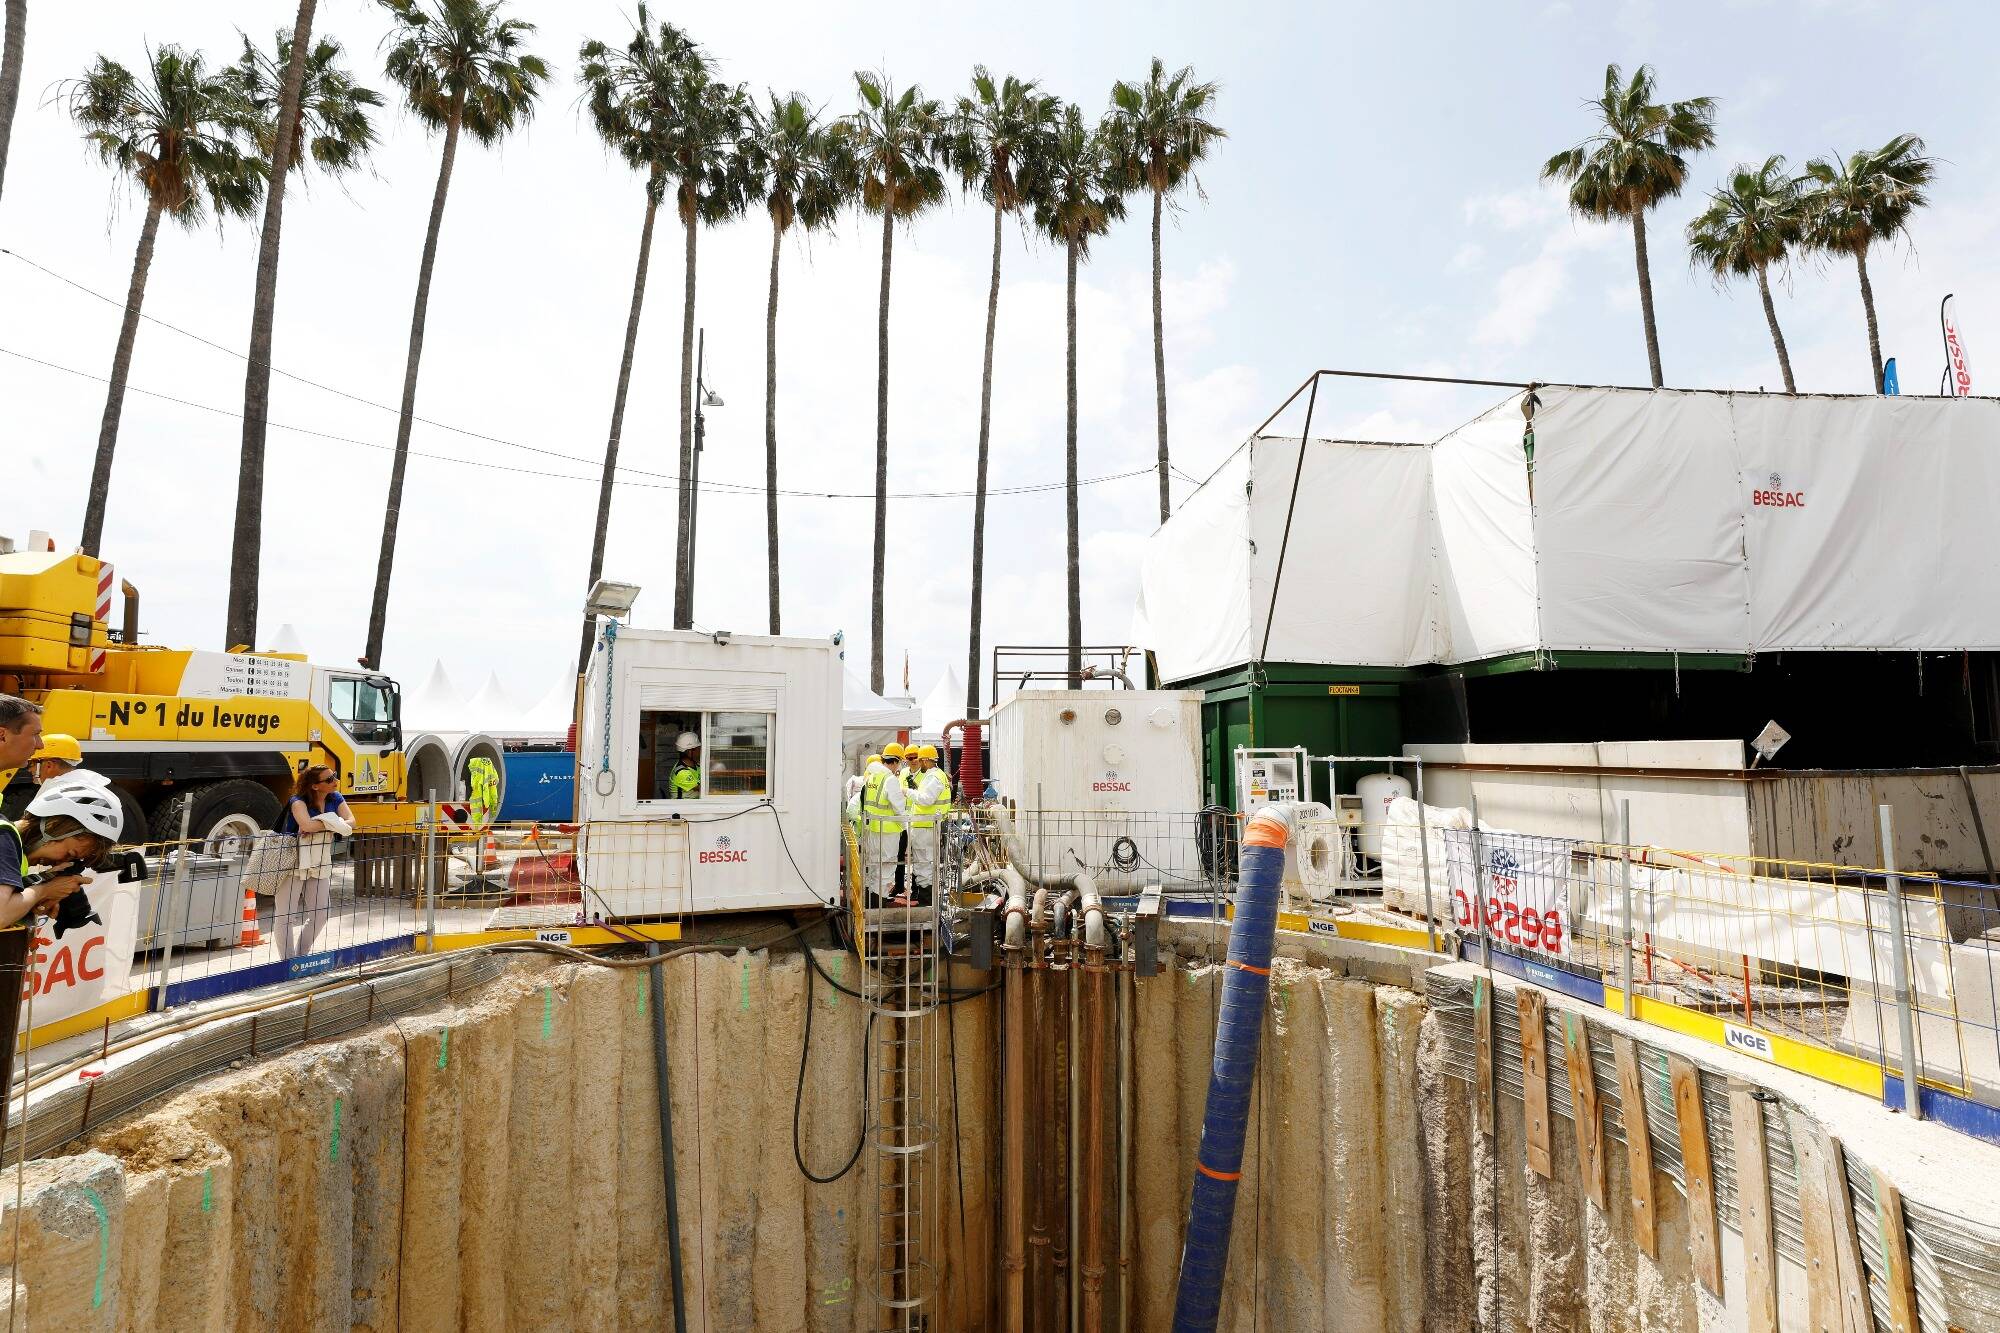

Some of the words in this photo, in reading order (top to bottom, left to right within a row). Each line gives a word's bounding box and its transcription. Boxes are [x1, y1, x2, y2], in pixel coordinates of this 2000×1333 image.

[155, 702, 166, 727] 1
[176, 703, 204, 728] du
[212, 705, 280, 735] levage
[1312, 921, 1335, 932] NGE
[540, 933, 568, 942] NGE
[1731, 1029, 1767, 1052] NGE
